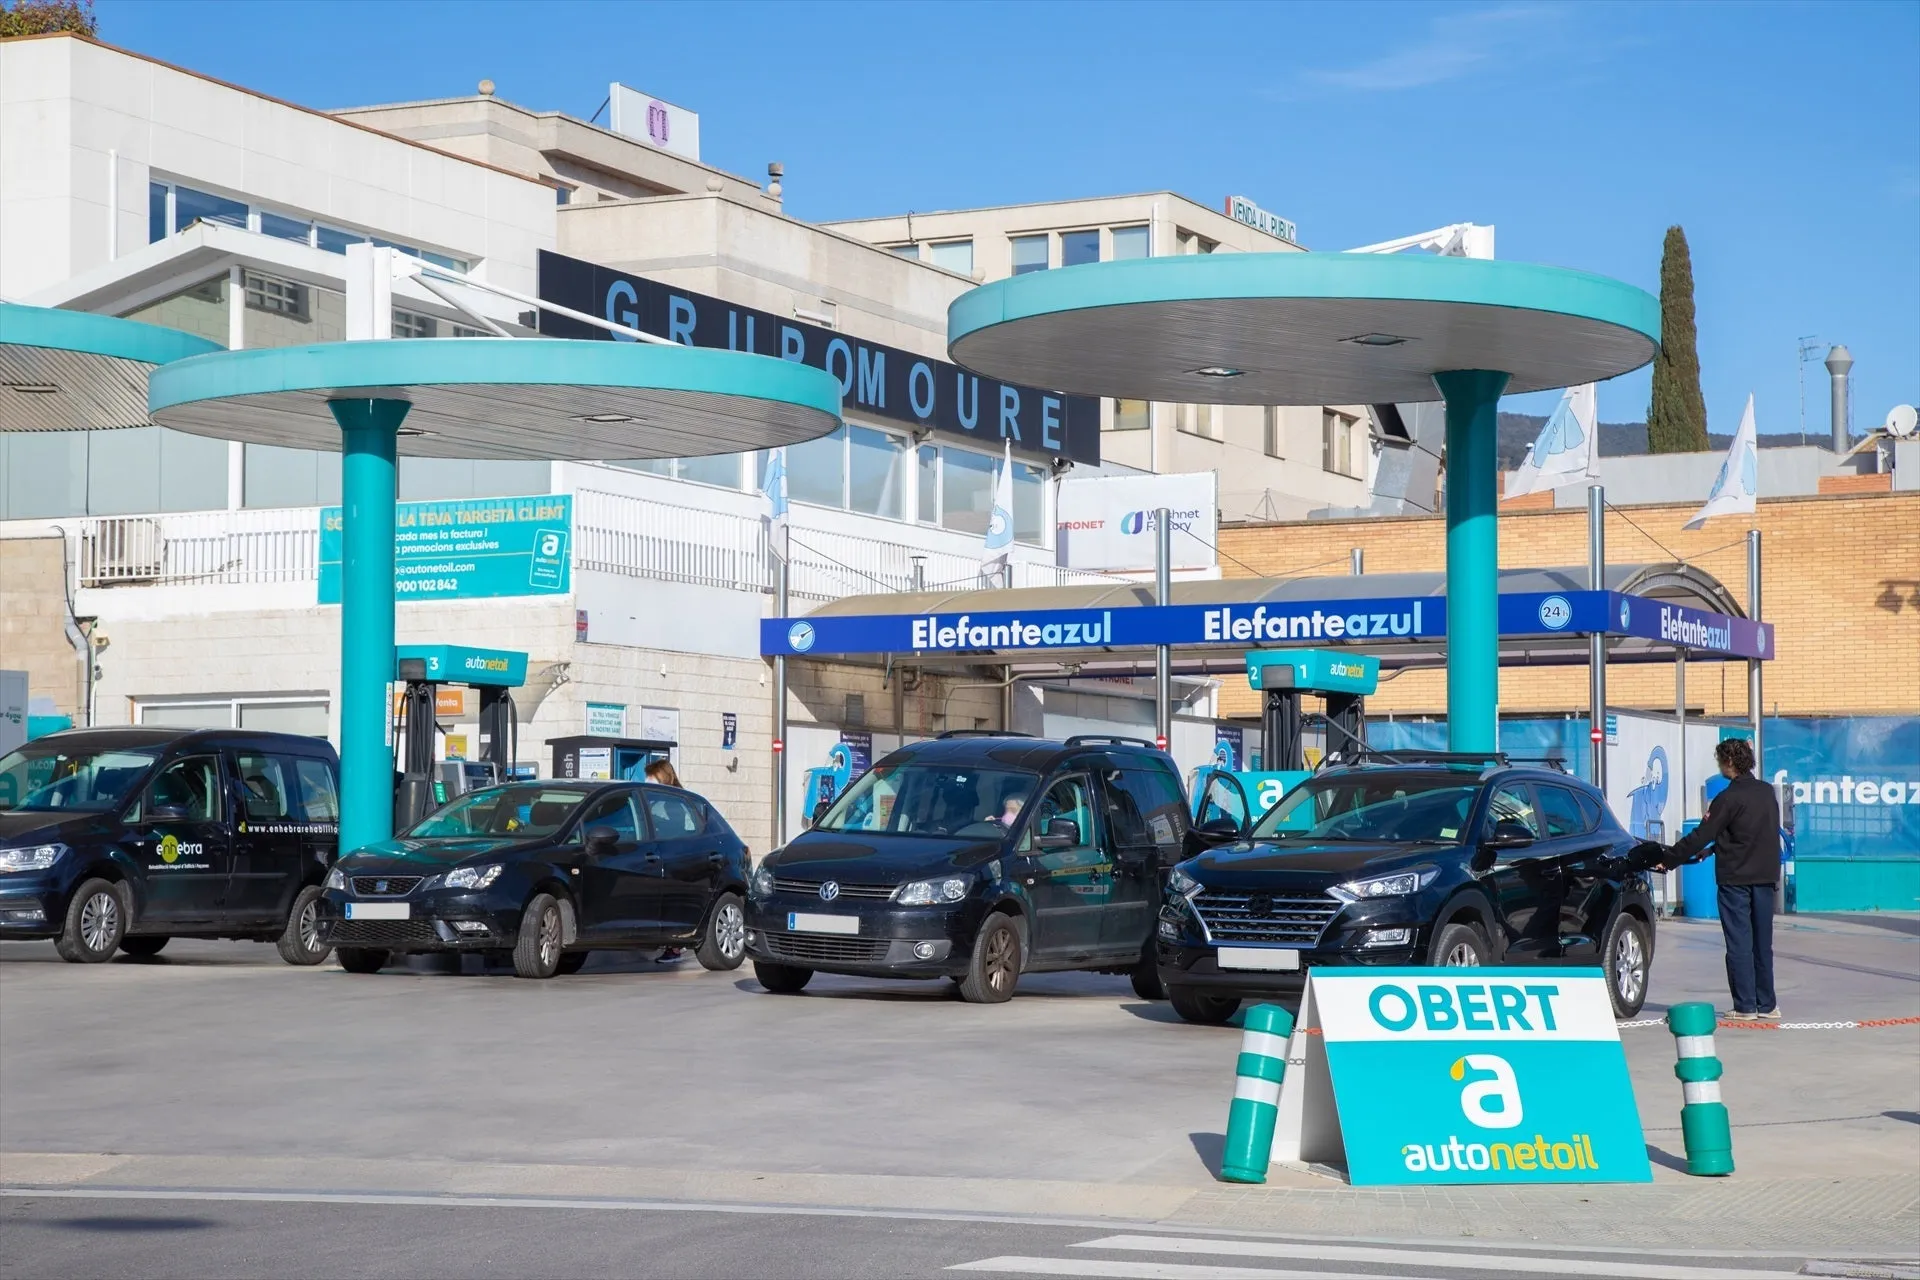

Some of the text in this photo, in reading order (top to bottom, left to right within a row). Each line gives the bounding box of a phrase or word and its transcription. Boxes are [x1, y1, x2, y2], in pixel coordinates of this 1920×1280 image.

[1232, 199, 1257, 228] VENDA
[1259, 211, 1269, 233] AL
[399, 505, 565, 528] LA TEVA TARGETA CLIENT
[419, 531, 438, 541] mes
[439, 529, 449, 540] la
[450, 528, 483, 540] factura
[401, 542, 454, 556] promocions
[455, 539, 499, 551] exclusives
[396, 578, 457, 593] 900 102 842
[1543, 606, 1561, 617] 24
[912, 610, 1111, 649] Elefanteazul
[1204, 601, 1422, 641] Elefanteazul
[1660, 606, 1731, 651] Elefanteazul
[429, 657, 439, 671] 3
[465, 656, 509, 672] autonetoil
[1299, 664, 1308, 679] 1
[1330, 661, 1365, 678] autonetoil
[1250, 666, 1259, 680] 2
[1368, 984, 1560, 1032] OBERT
[1401, 1134, 1599, 1172] autonetoil
